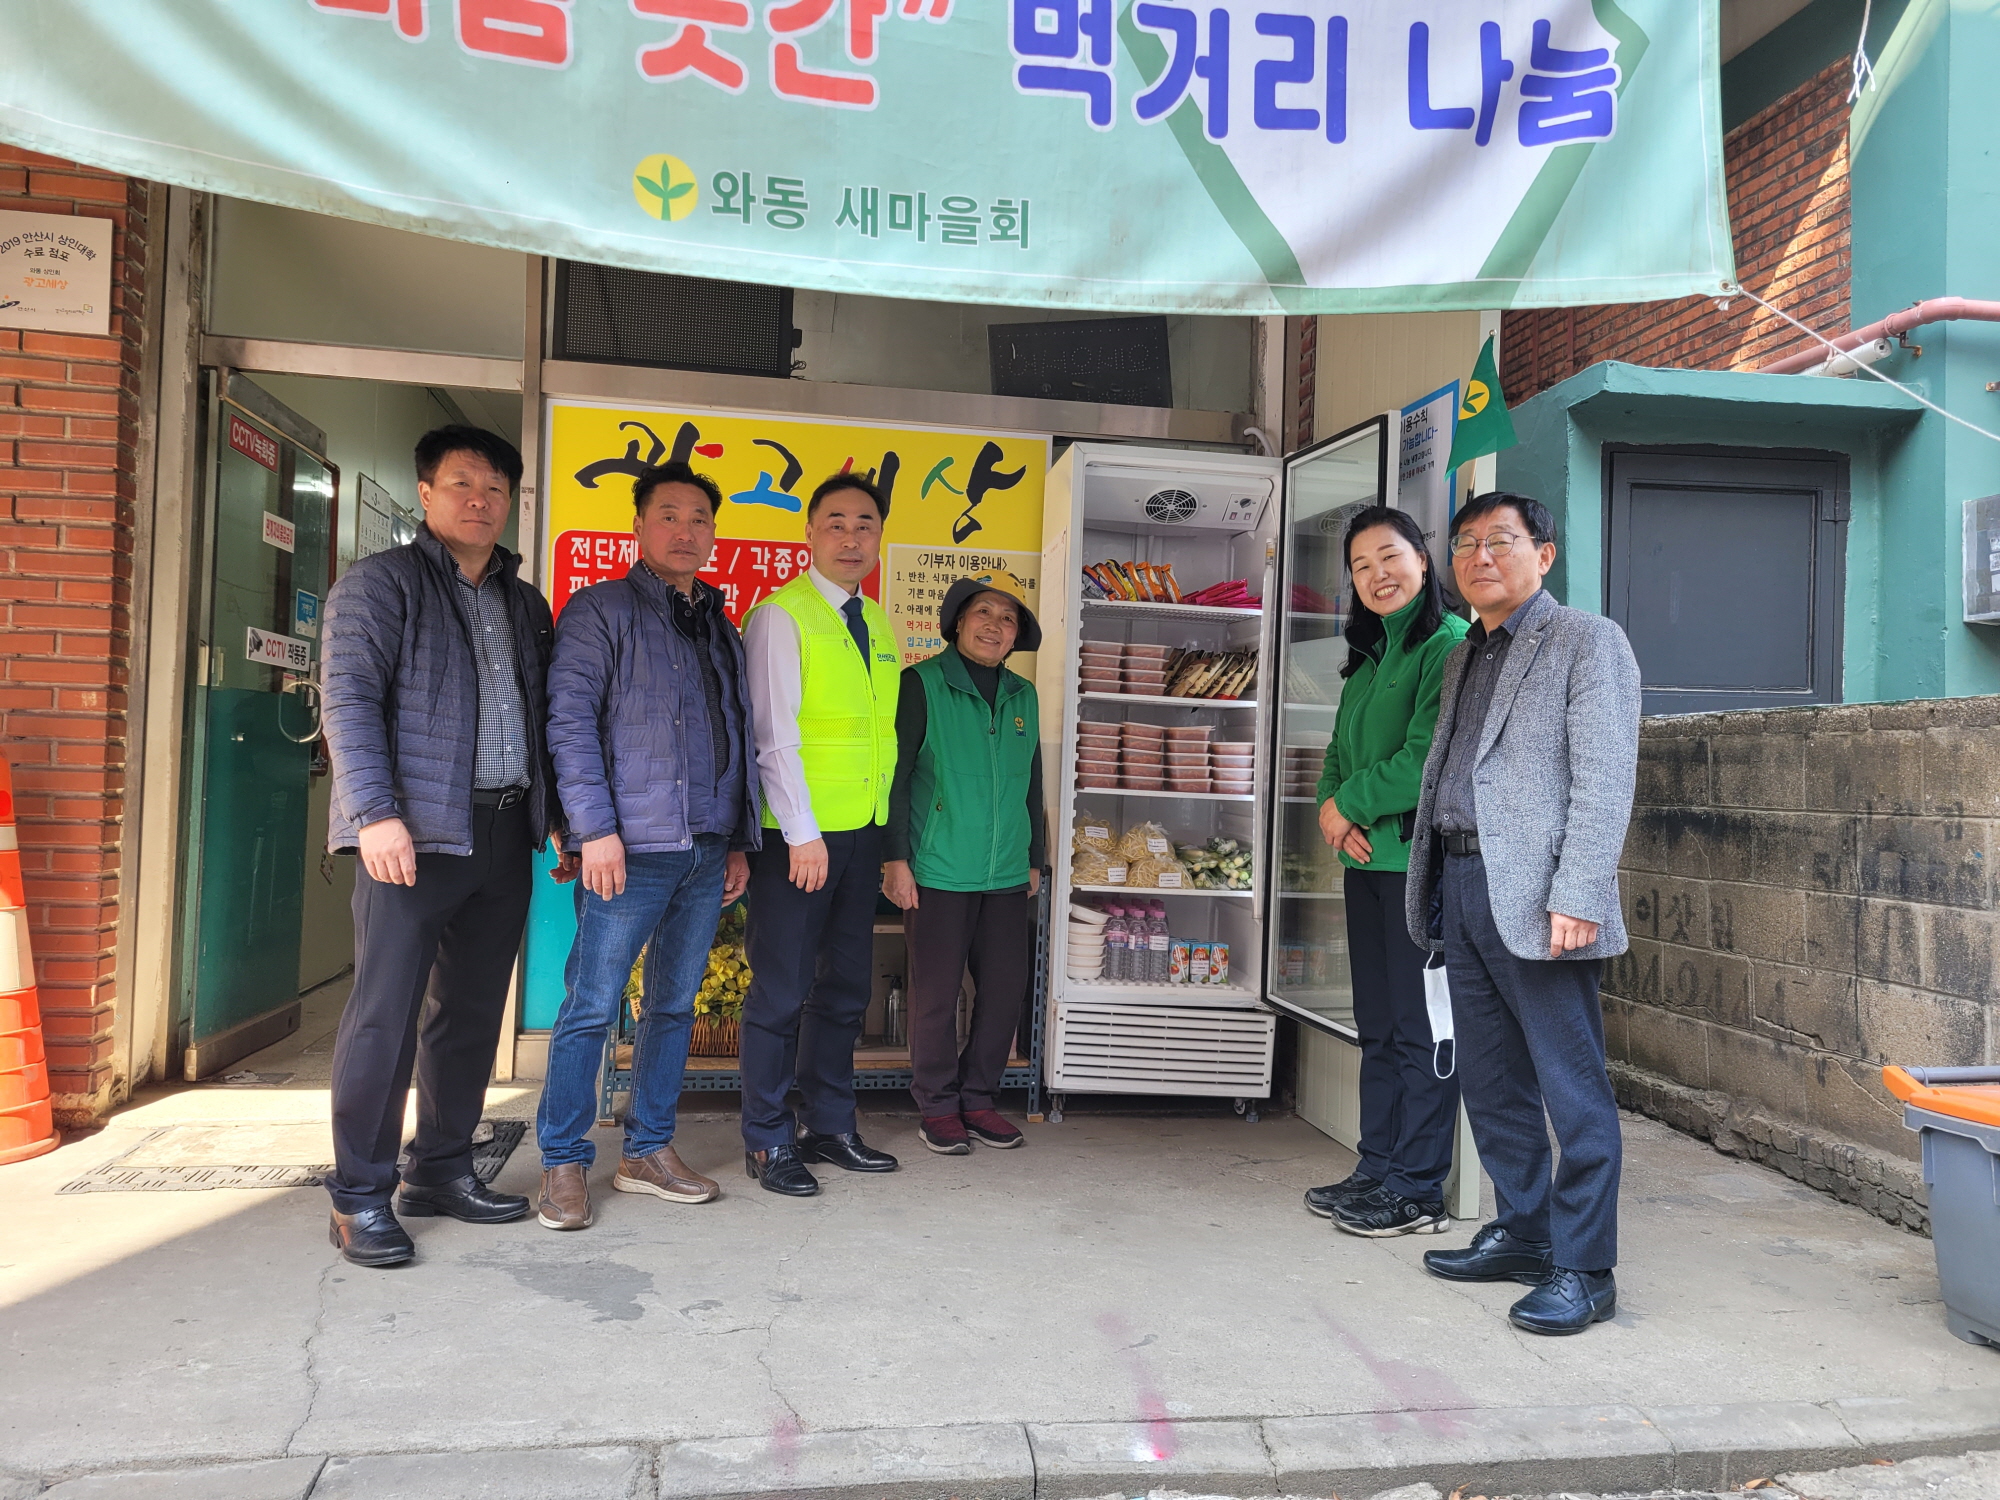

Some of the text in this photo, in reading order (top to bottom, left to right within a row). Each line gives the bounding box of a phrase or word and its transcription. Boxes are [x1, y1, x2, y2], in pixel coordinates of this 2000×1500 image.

[1011, 0, 1348, 145] 먹거리
[1408, 19, 1617, 148] 나눔
[711, 171, 1030, 250] 와동 새마을회
[0, 231, 97, 261] 2019 안산시 상인대학
[23, 246, 70, 262] 수료 점포
[29, 267, 61, 276] 와동 상인회
[23, 276, 69, 290] 광고세상
[232, 421, 276, 466] CCTV녹화중
[907, 588, 925, 600] 기쁜
[906, 604, 933, 616] 아래에
[906, 620, 932, 632] 먹거리
[265, 638, 307, 666] CCTV 작동중
